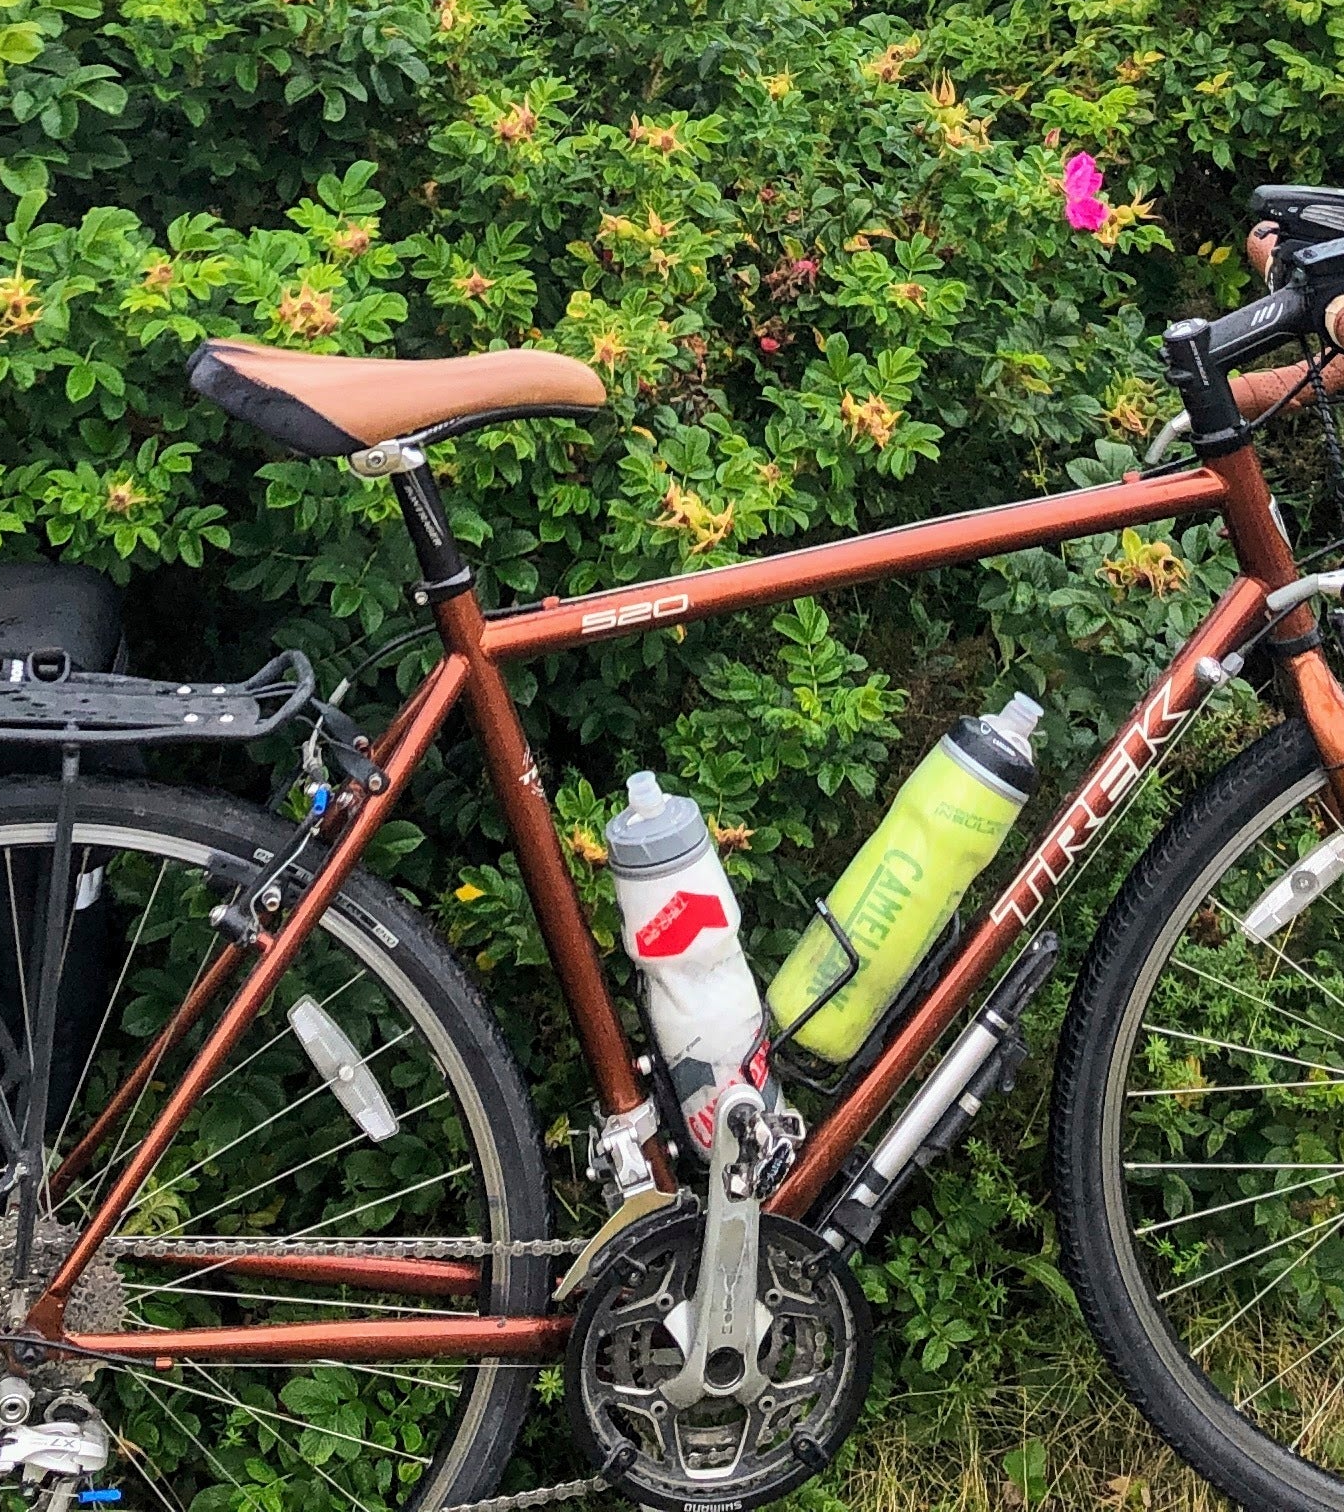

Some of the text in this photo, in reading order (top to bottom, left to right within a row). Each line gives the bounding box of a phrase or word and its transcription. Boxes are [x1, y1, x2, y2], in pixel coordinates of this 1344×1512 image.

[582, 593, 689, 634] 520
[989, 676, 1192, 926] TREK
[683, 1500, 743, 1512] SHIMANO
